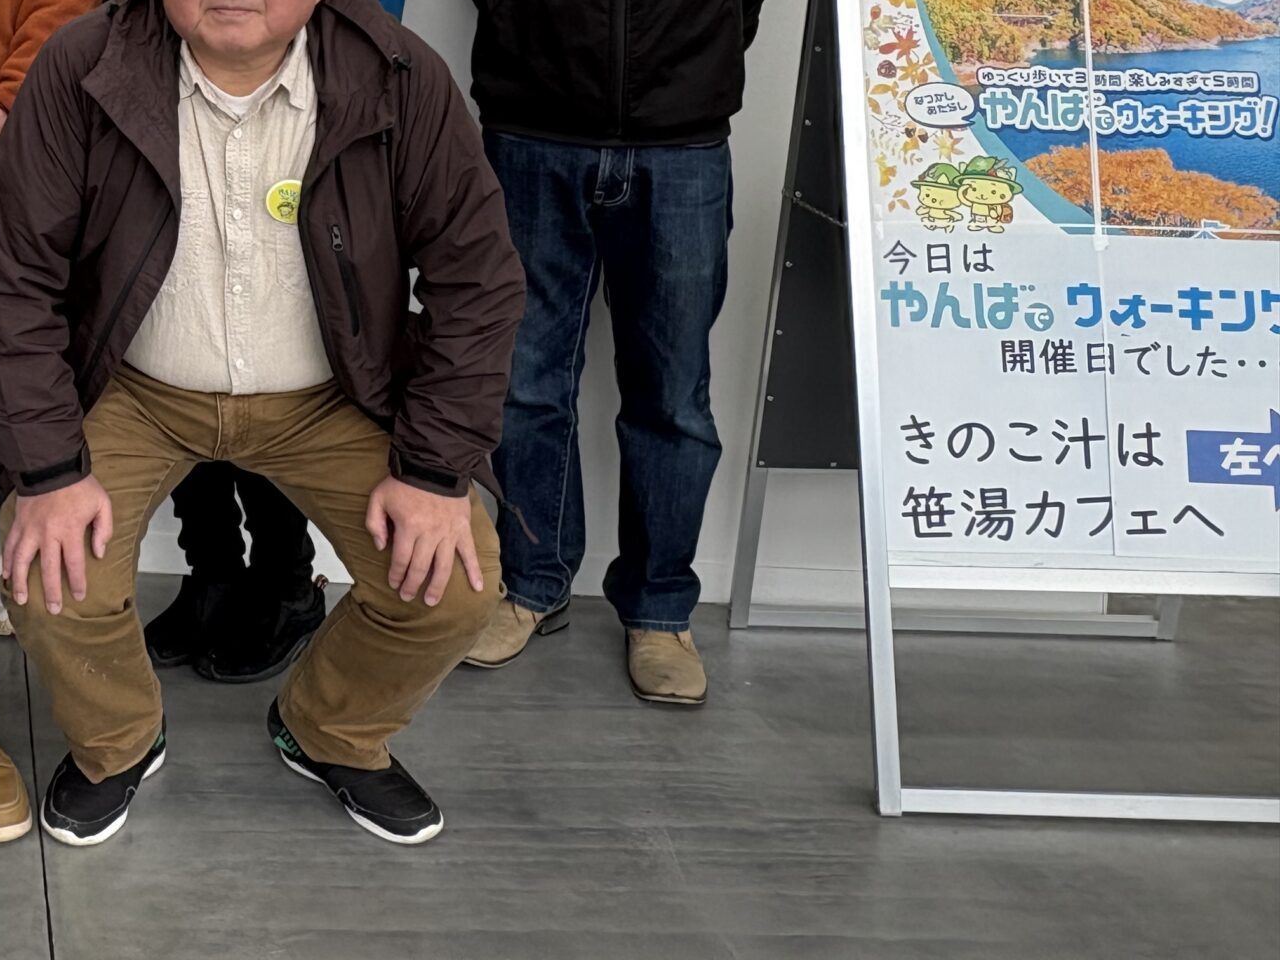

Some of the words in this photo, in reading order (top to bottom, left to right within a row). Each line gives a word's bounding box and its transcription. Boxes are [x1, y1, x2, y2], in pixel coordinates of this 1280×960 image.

[883, 239, 995, 275] 今日は
[899, 414, 1164, 470] きのこ汁は
[901, 485, 1225, 541] 笹湯カフェへ
